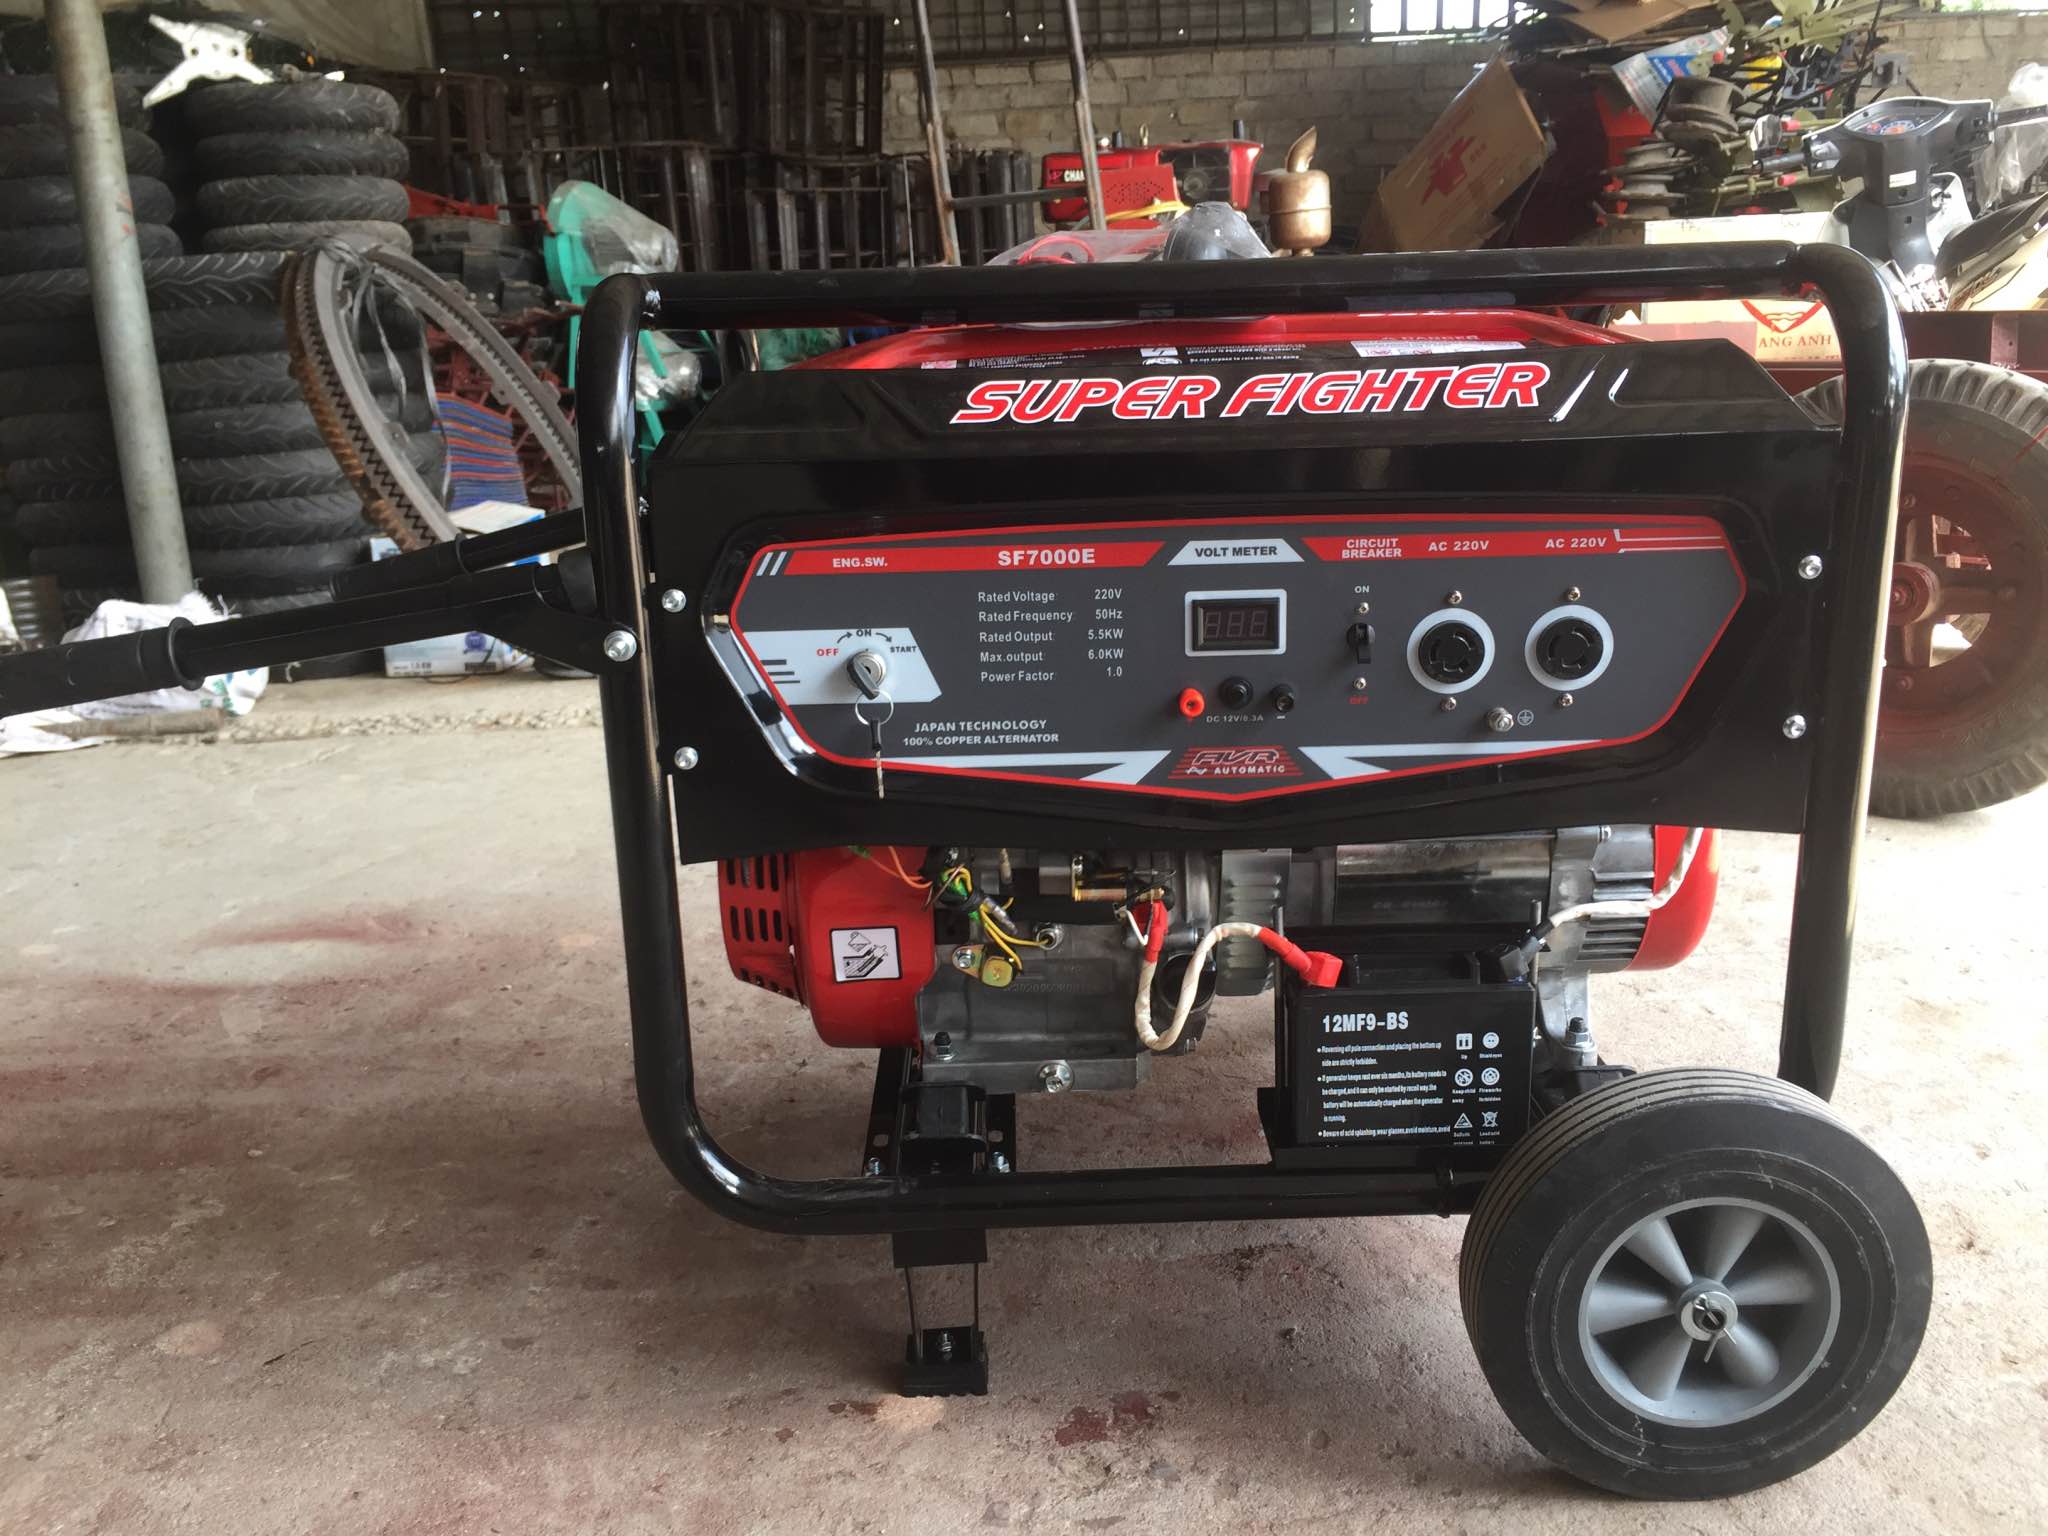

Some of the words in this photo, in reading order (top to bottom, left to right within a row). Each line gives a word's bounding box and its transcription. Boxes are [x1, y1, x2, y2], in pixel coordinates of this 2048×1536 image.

[1797, 335, 1832, 346] ANH
[950, 375, 1220, 424] SUPER
[1219, 362, 1550, 418] FIGHTER
[1346, 538, 1399, 549] CIRCUIT
[1429, 542, 1447, 552] AC
[1453, 541, 1489, 551] 220V
[1545, 538, 1564, 549] AC
[1571, 537, 1607, 548] 220V
[997, 549, 1095, 566] SF7000E
[1195, 547, 1229, 558] VOLT
[1232, 546, 1277, 557] METER
[1342, 548, 1402, 559] BREAKER
[832, 556, 888, 568] ENG.SW.
[1094, 588, 1122, 600] 220V
[1354, 585, 1370, 593] ON
[978, 592, 1011, 603] Rated
[1013, 591, 1055, 604] Voltage
[978, 611, 1011, 622] Rated
[1013, 610, 1073, 623] Frequency
[1095, 608, 1123, 620] 50Hz
[856, 629, 872, 637] ON
[979, 631, 1012, 643] Rated
[1014, 631, 1053, 643] Output
[1087, 628, 1124, 640] 5.5KW
[816, 648, 839, 656] OFF
[980, 651, 1043, 664] Max.output
[1087, 648, 1124, 660] 6.0KW
[981, 671, 1015, 682] Power
[1018, 670, 1054, 681] Factor
[1106, 666, 1122, 677] 1.0
[1206, 715, 1220, 723] DC
[914, 722, 956, 733] JAPAN
[959, 720, 1047, 732] TECHNOLOGY
[903, 737, 933, 746] 100%
[935, 735, 982, 746] COPPER
[984, 733, 1059, 744] ALTERNATOR
[1191, 749, 1279, 765] AVR
[1214, 765, 1285, 774] AUTOMATIC
[1322, 1011, 1409, 1032] 12MF9-BS
